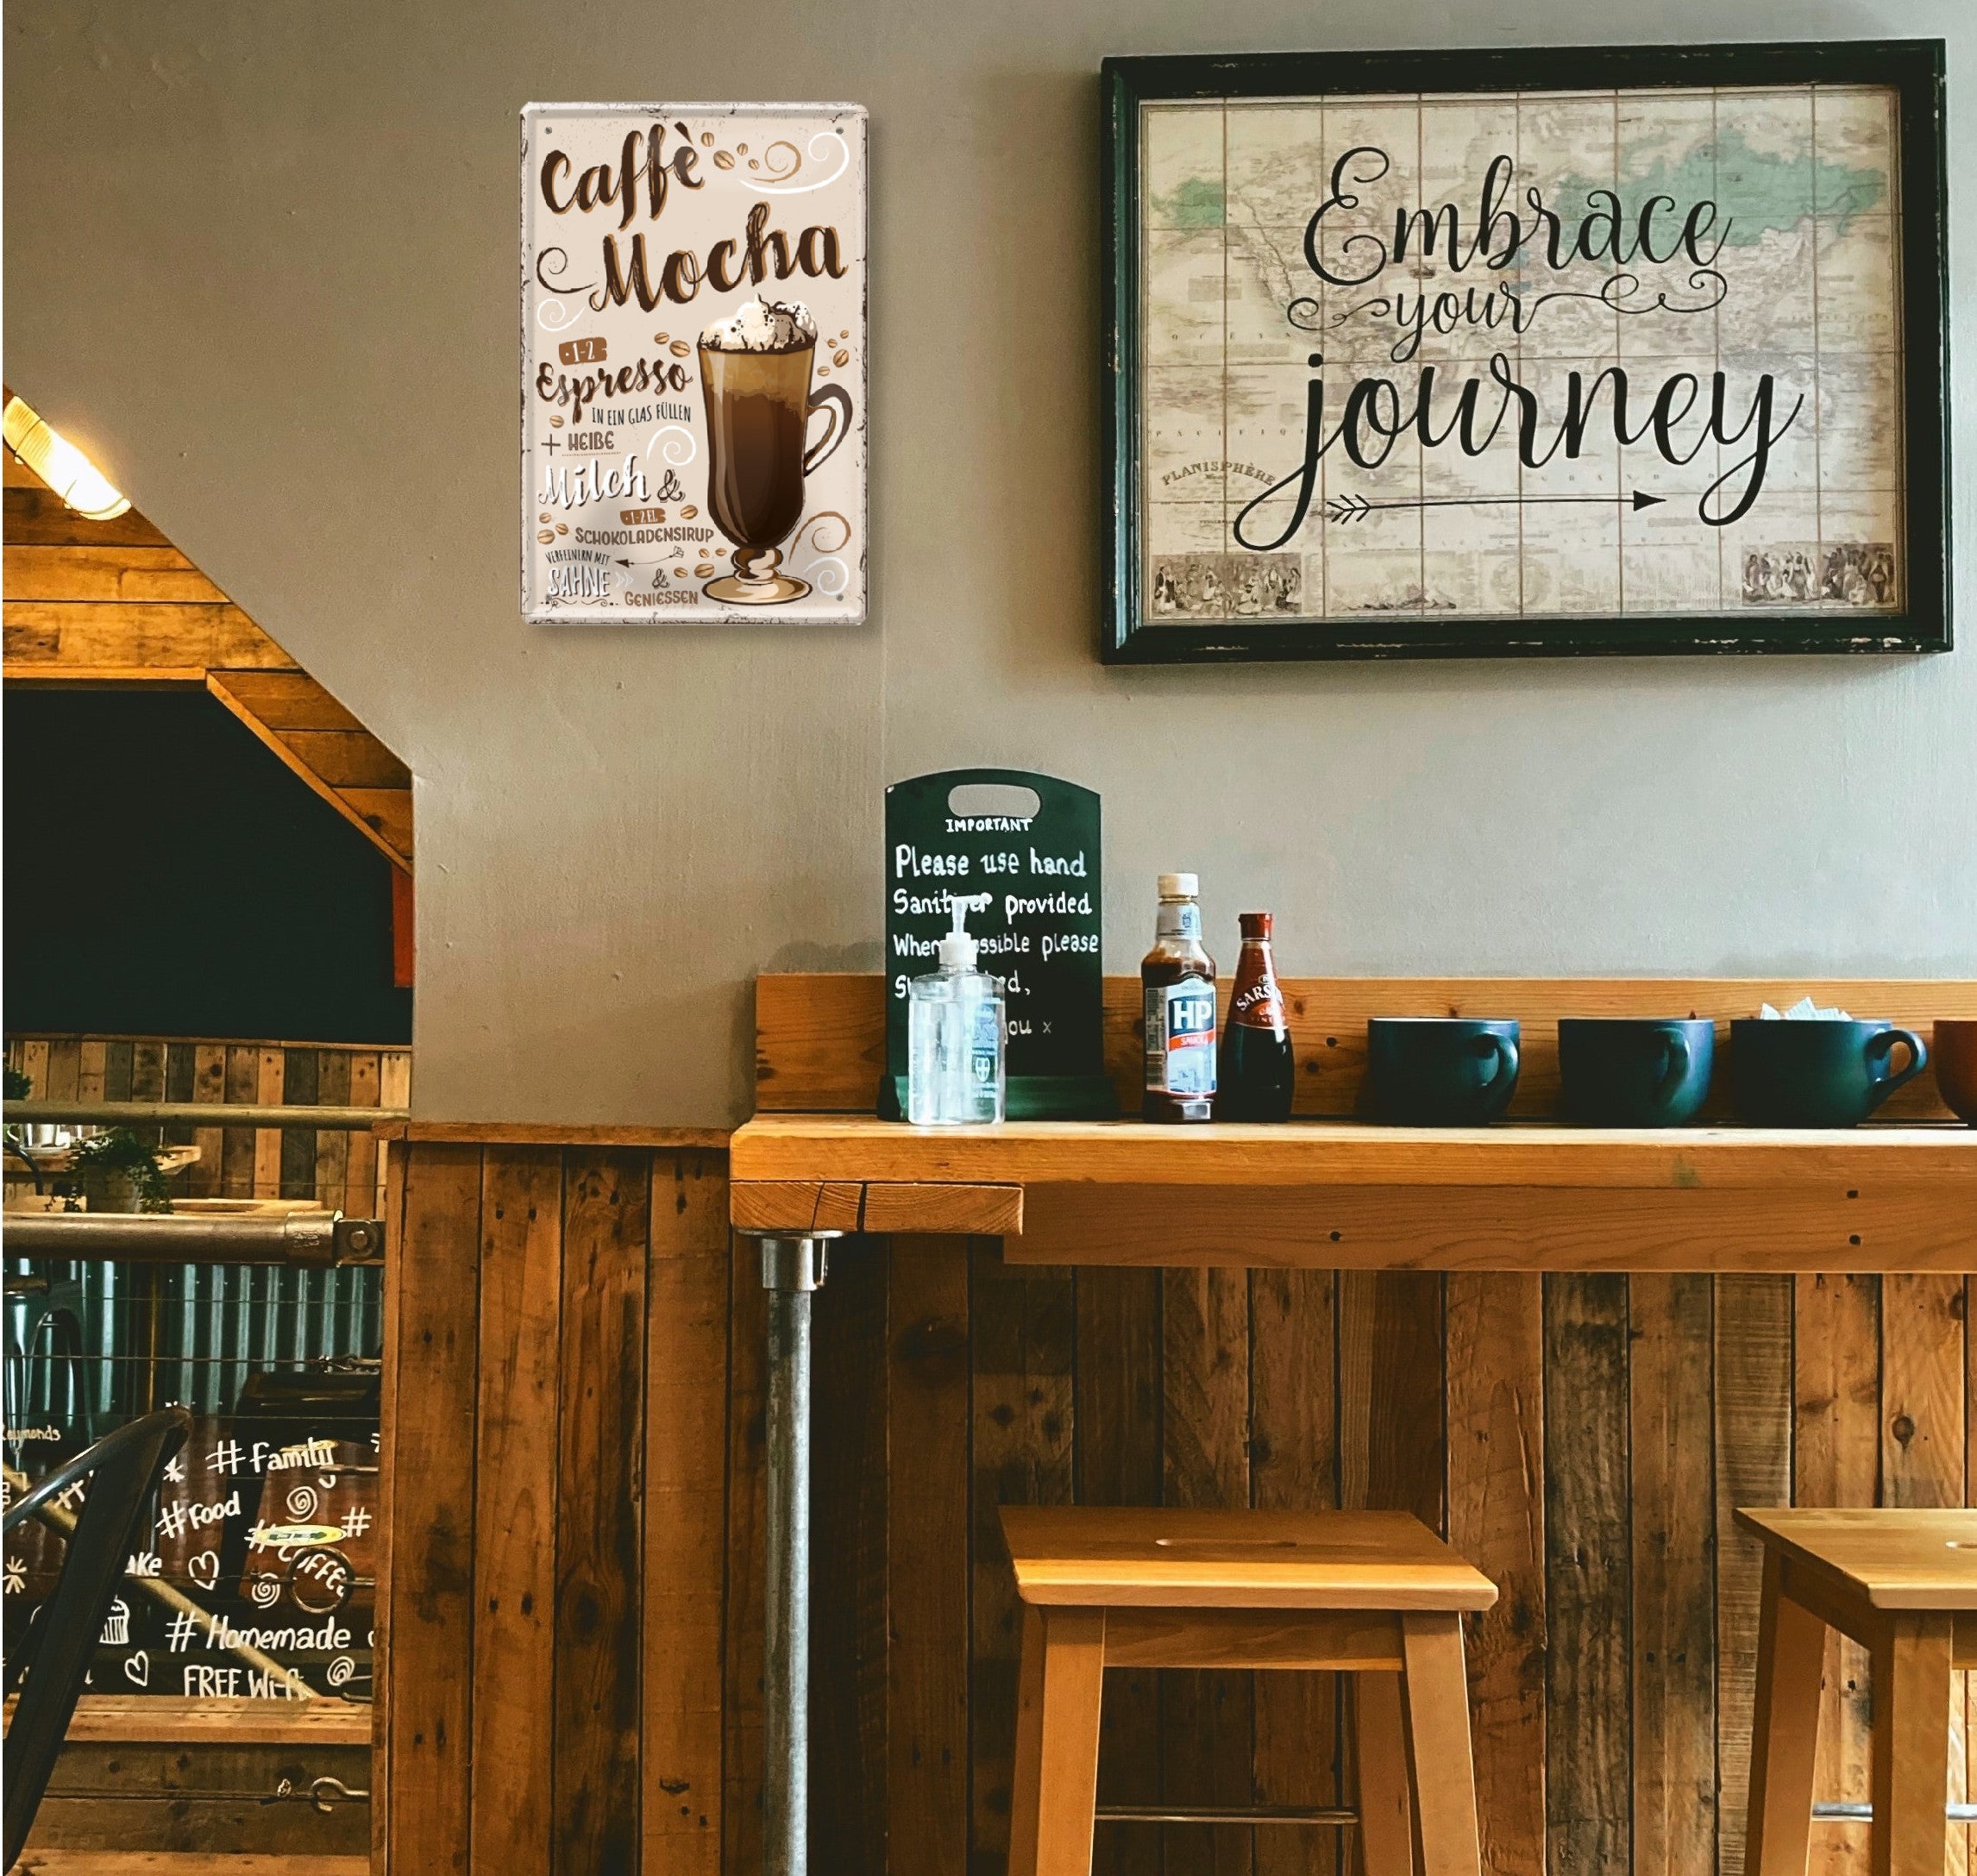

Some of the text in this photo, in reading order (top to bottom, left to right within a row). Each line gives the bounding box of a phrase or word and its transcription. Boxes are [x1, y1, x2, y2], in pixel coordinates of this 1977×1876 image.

[540, 122, 705, 229] Caffè
[1303, 147, 1733, 285] Embrace
[588, 201, 849, 313] Mocha
[1390, 280, 1538, 363] your
[536, 358, 694, 425] Espresso
[592, 401, 691, 426] IN EIN GLAS FÜLLEN
[1233, 353, 1804, 551] journey
[537, 454, 686, 511] Milch &
[547, 564, 611, 598] SAHNE
[651, 568, 671, 589] &
[945, 818, 1033, 833] IMPORTANT
[895, 844, 1087, 879] Please use hand
[1005, 890, 1093, 925] provided
[1041, 934, 1099, 962] please
[1173, 1001, 1212, 1030] HP
[184, 1665, 242, 1698] FREE
